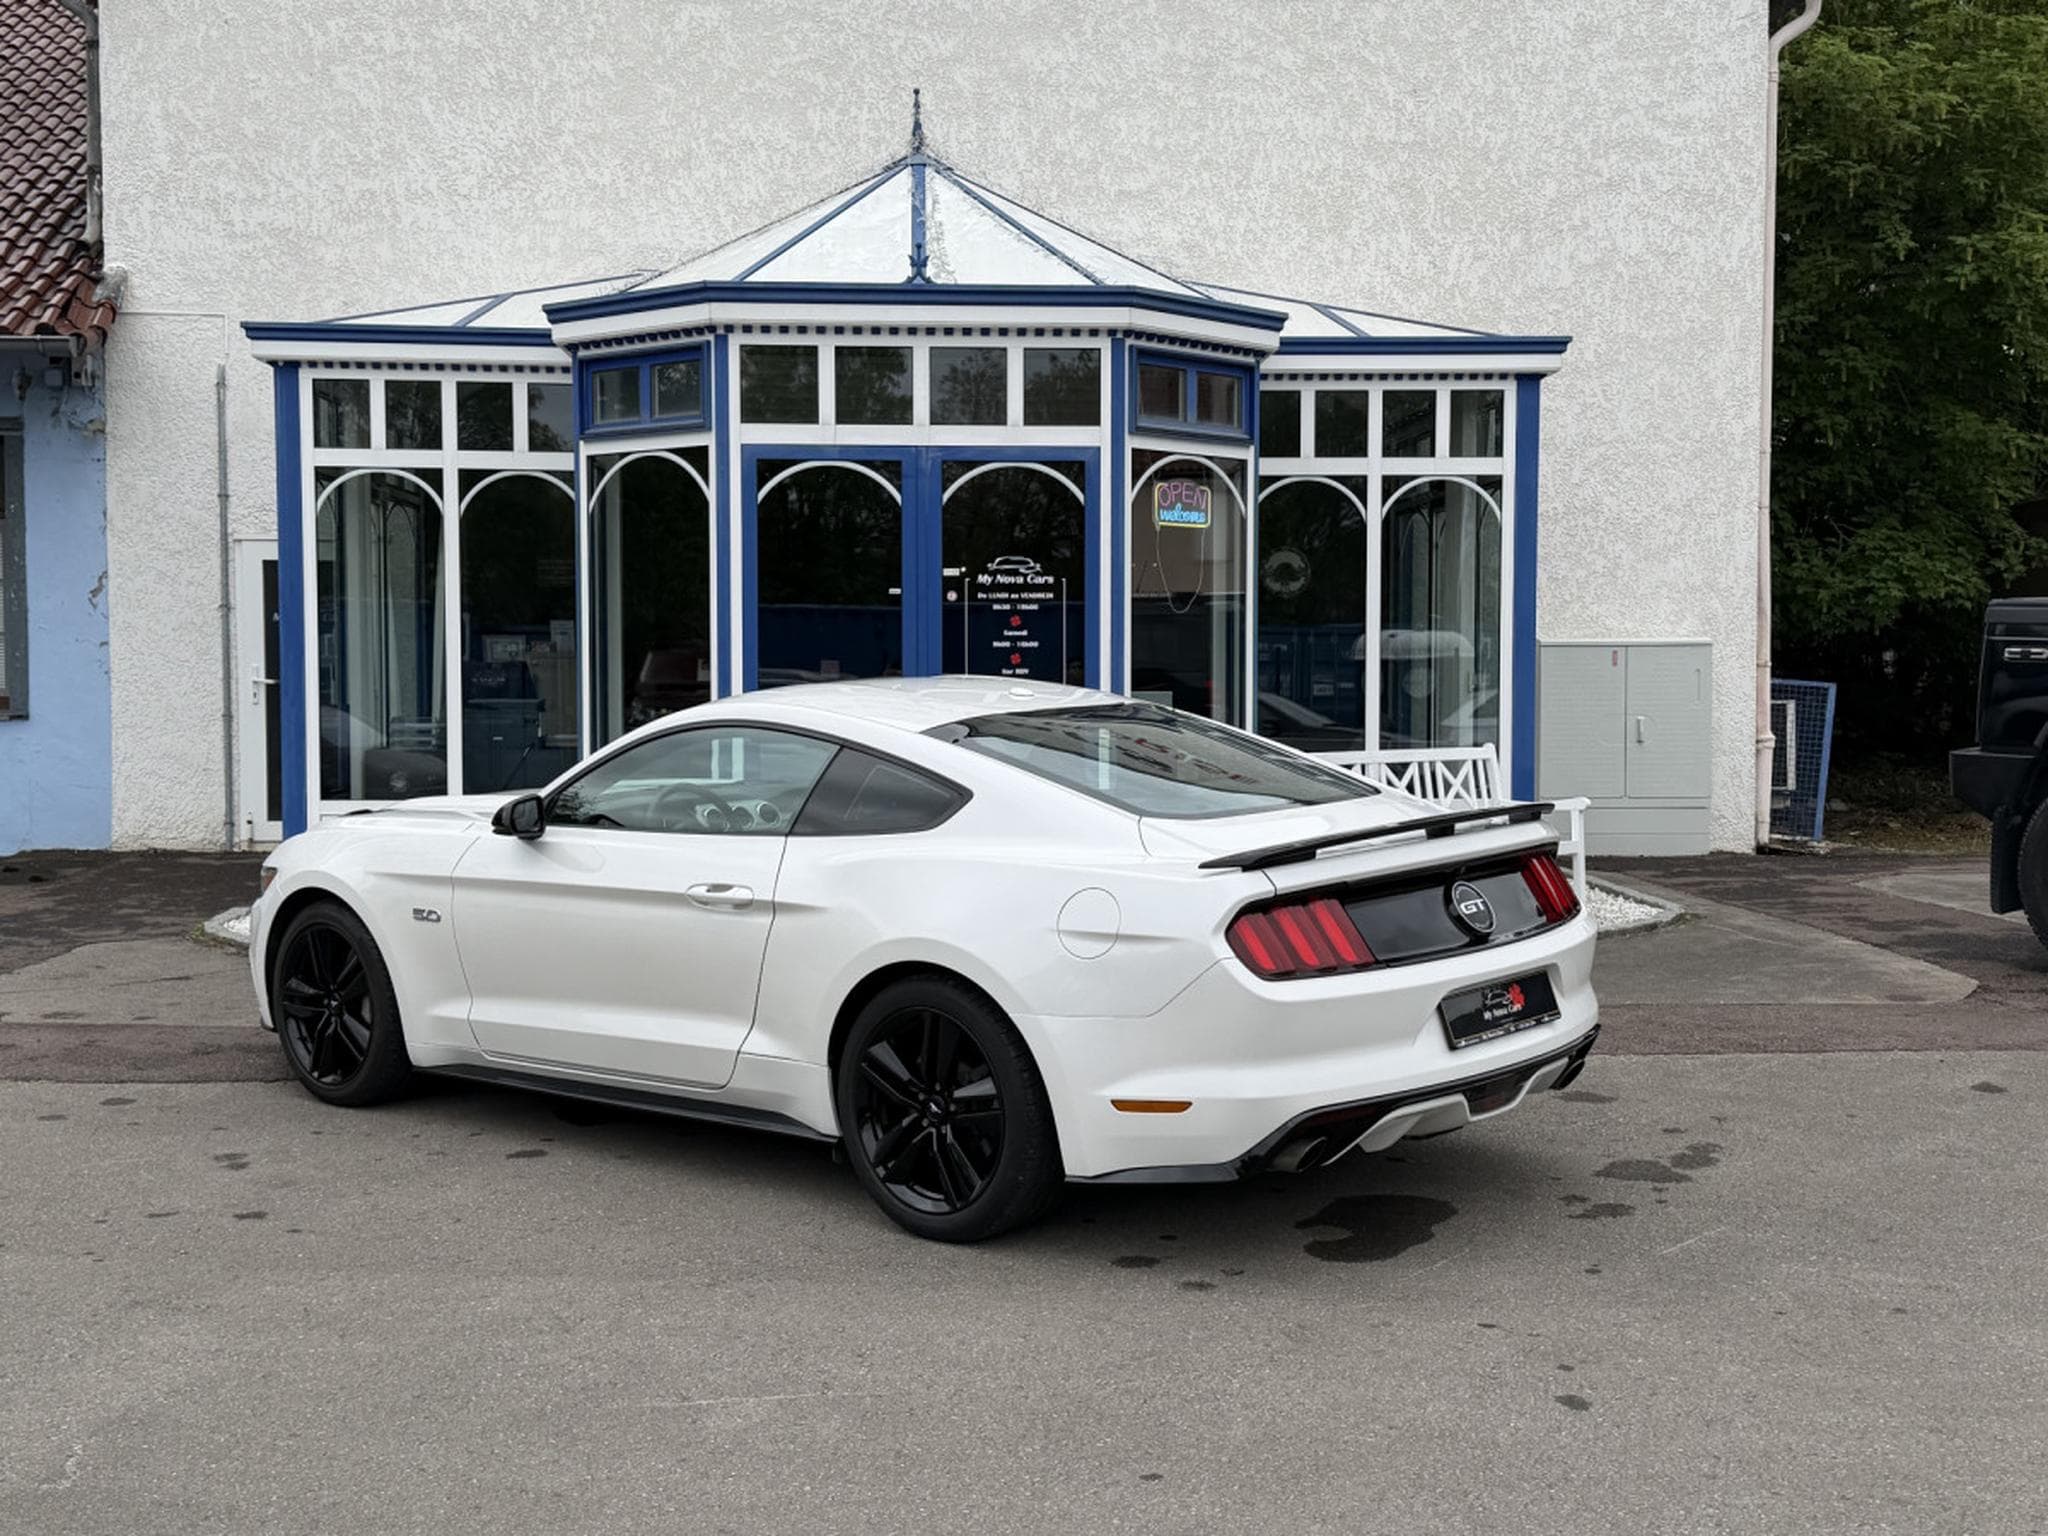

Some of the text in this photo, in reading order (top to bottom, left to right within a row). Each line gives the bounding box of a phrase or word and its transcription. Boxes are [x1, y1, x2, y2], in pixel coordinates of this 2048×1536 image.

[1159, 482, 1207, 509] OPEN
[976, 573, 1054, 586] My Nova Cars
[1460, 898, 1484, 914] GT
